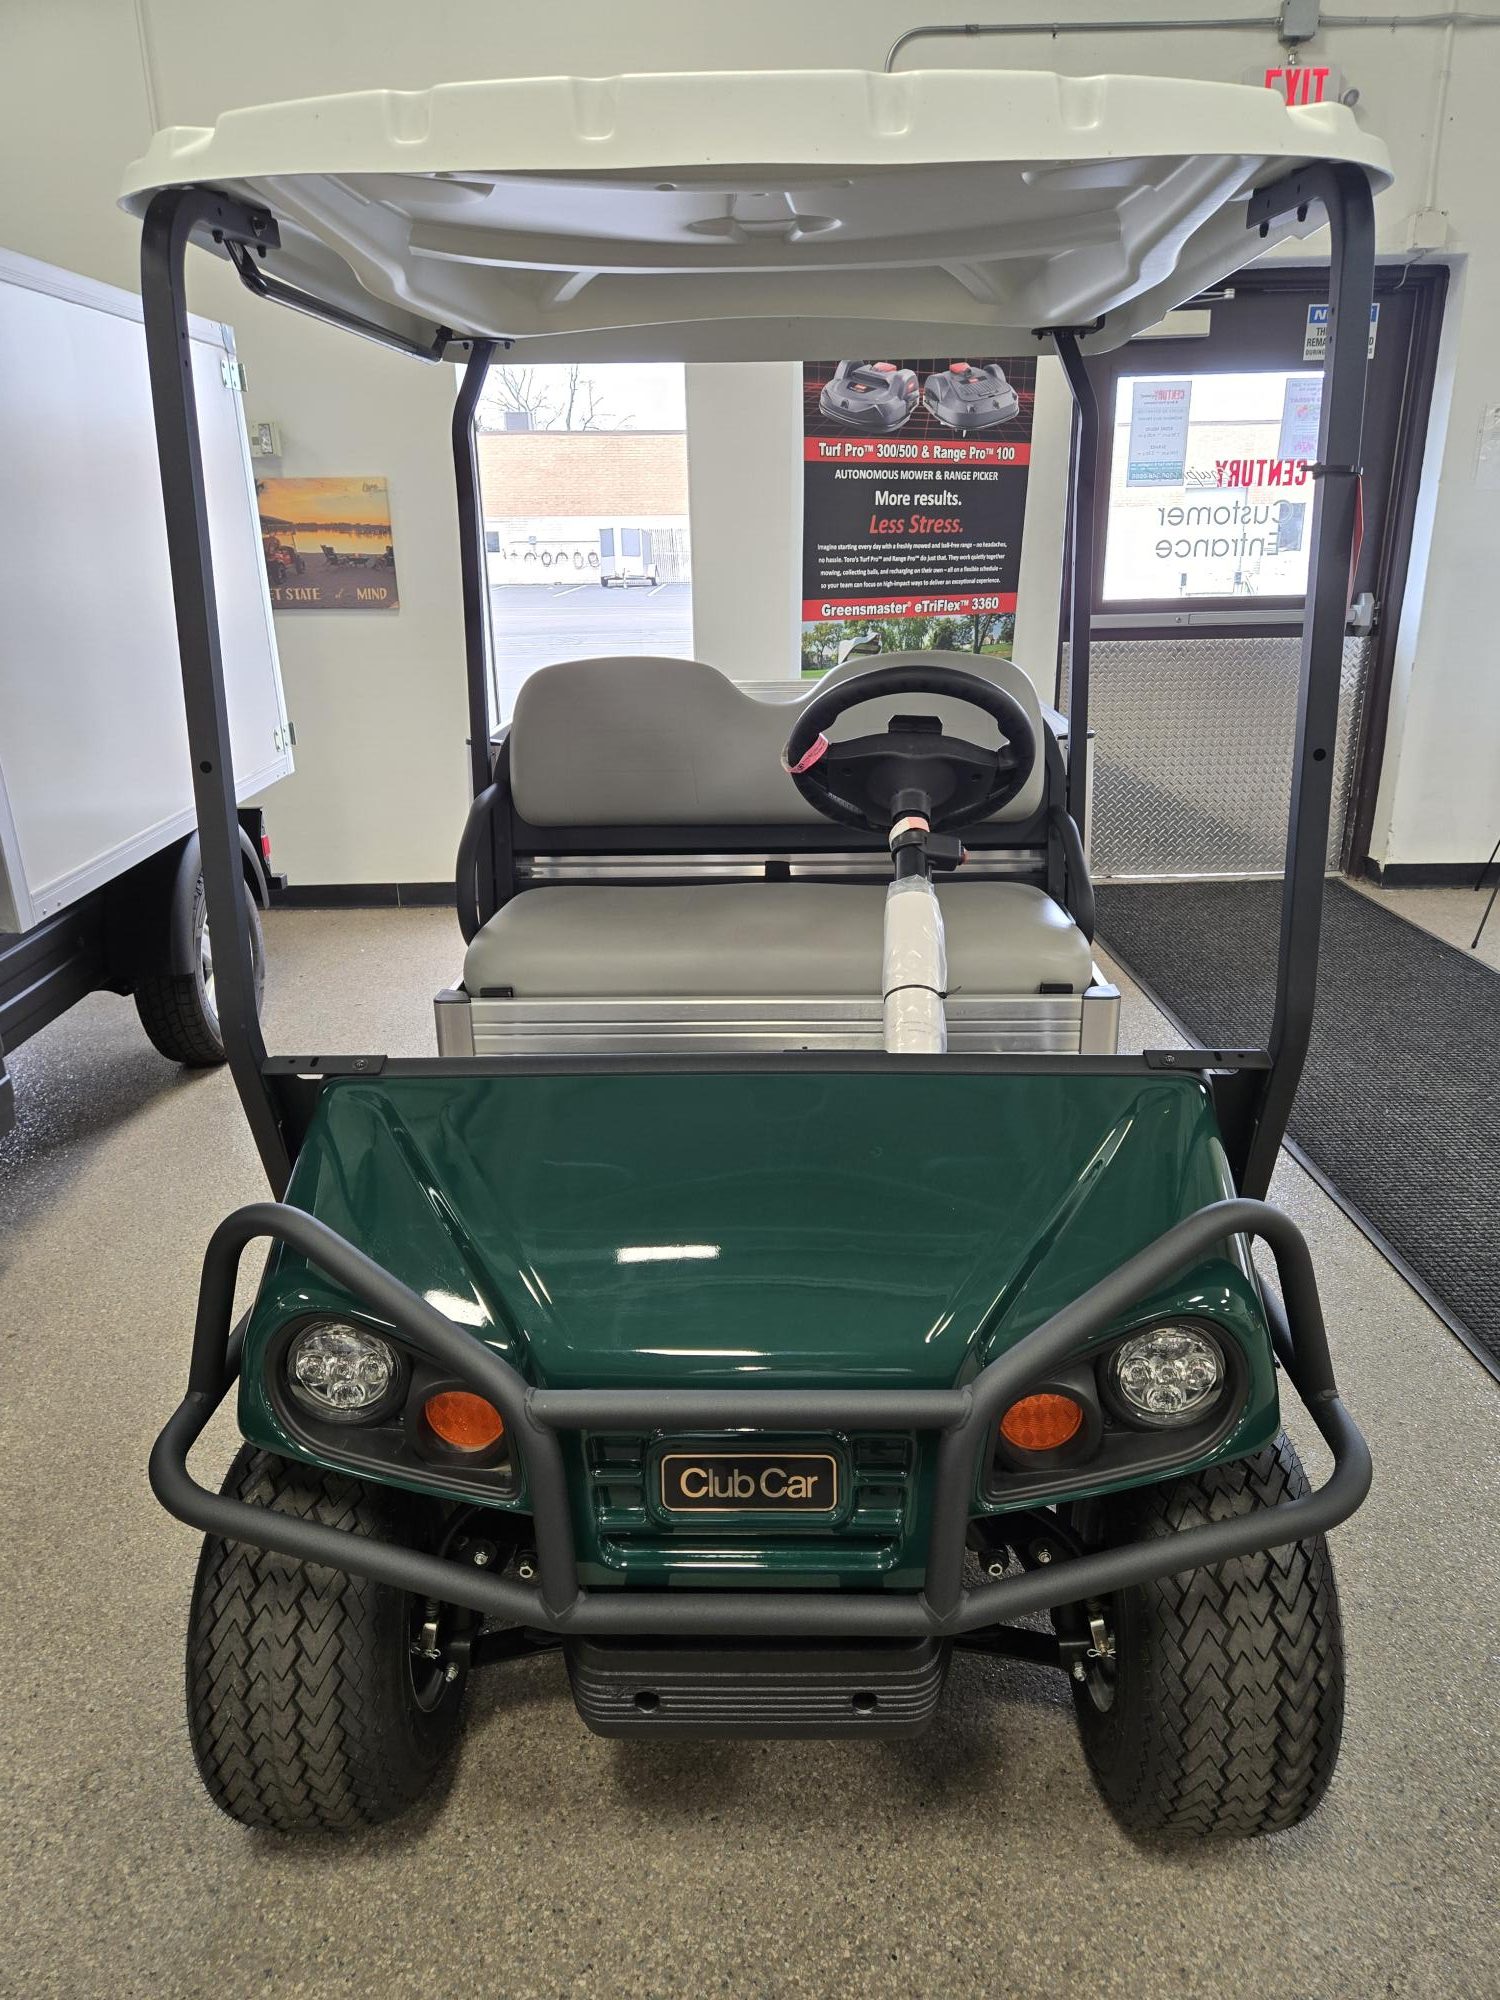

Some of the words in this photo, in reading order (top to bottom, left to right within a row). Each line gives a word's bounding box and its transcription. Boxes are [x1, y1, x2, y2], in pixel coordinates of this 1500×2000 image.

[818, 442, 842, 457] Turf
[876, 444, 918, 458] 300/500
[921, 445, 930, 458] &
[933, 445, 967, 462] Range
[996, 447, 1015, 460] 100
[834, 469, 899, 480] AUTONOMOUS
[900, 470, 934, 480] MOWER
[935, 470, 943, 480] &
[943, 471, 972, 481] RANGE
[972, 471, 999, 481] PICKER
[875, 490, 911, 506] More
[914, 490, 962, 506] results.
[869, 515, 905, 534] Less
[909, 514, 964, 534] Stress.
[897, 542, 912, 550] freshly
[285, 587, 321, 600] STATE
[356, 587, 388, 600] MIND
[971, 597, 999, 610] 3360
[680, 1467, 755, 1498] Club
[760, 1467, 818, 1498] Car
